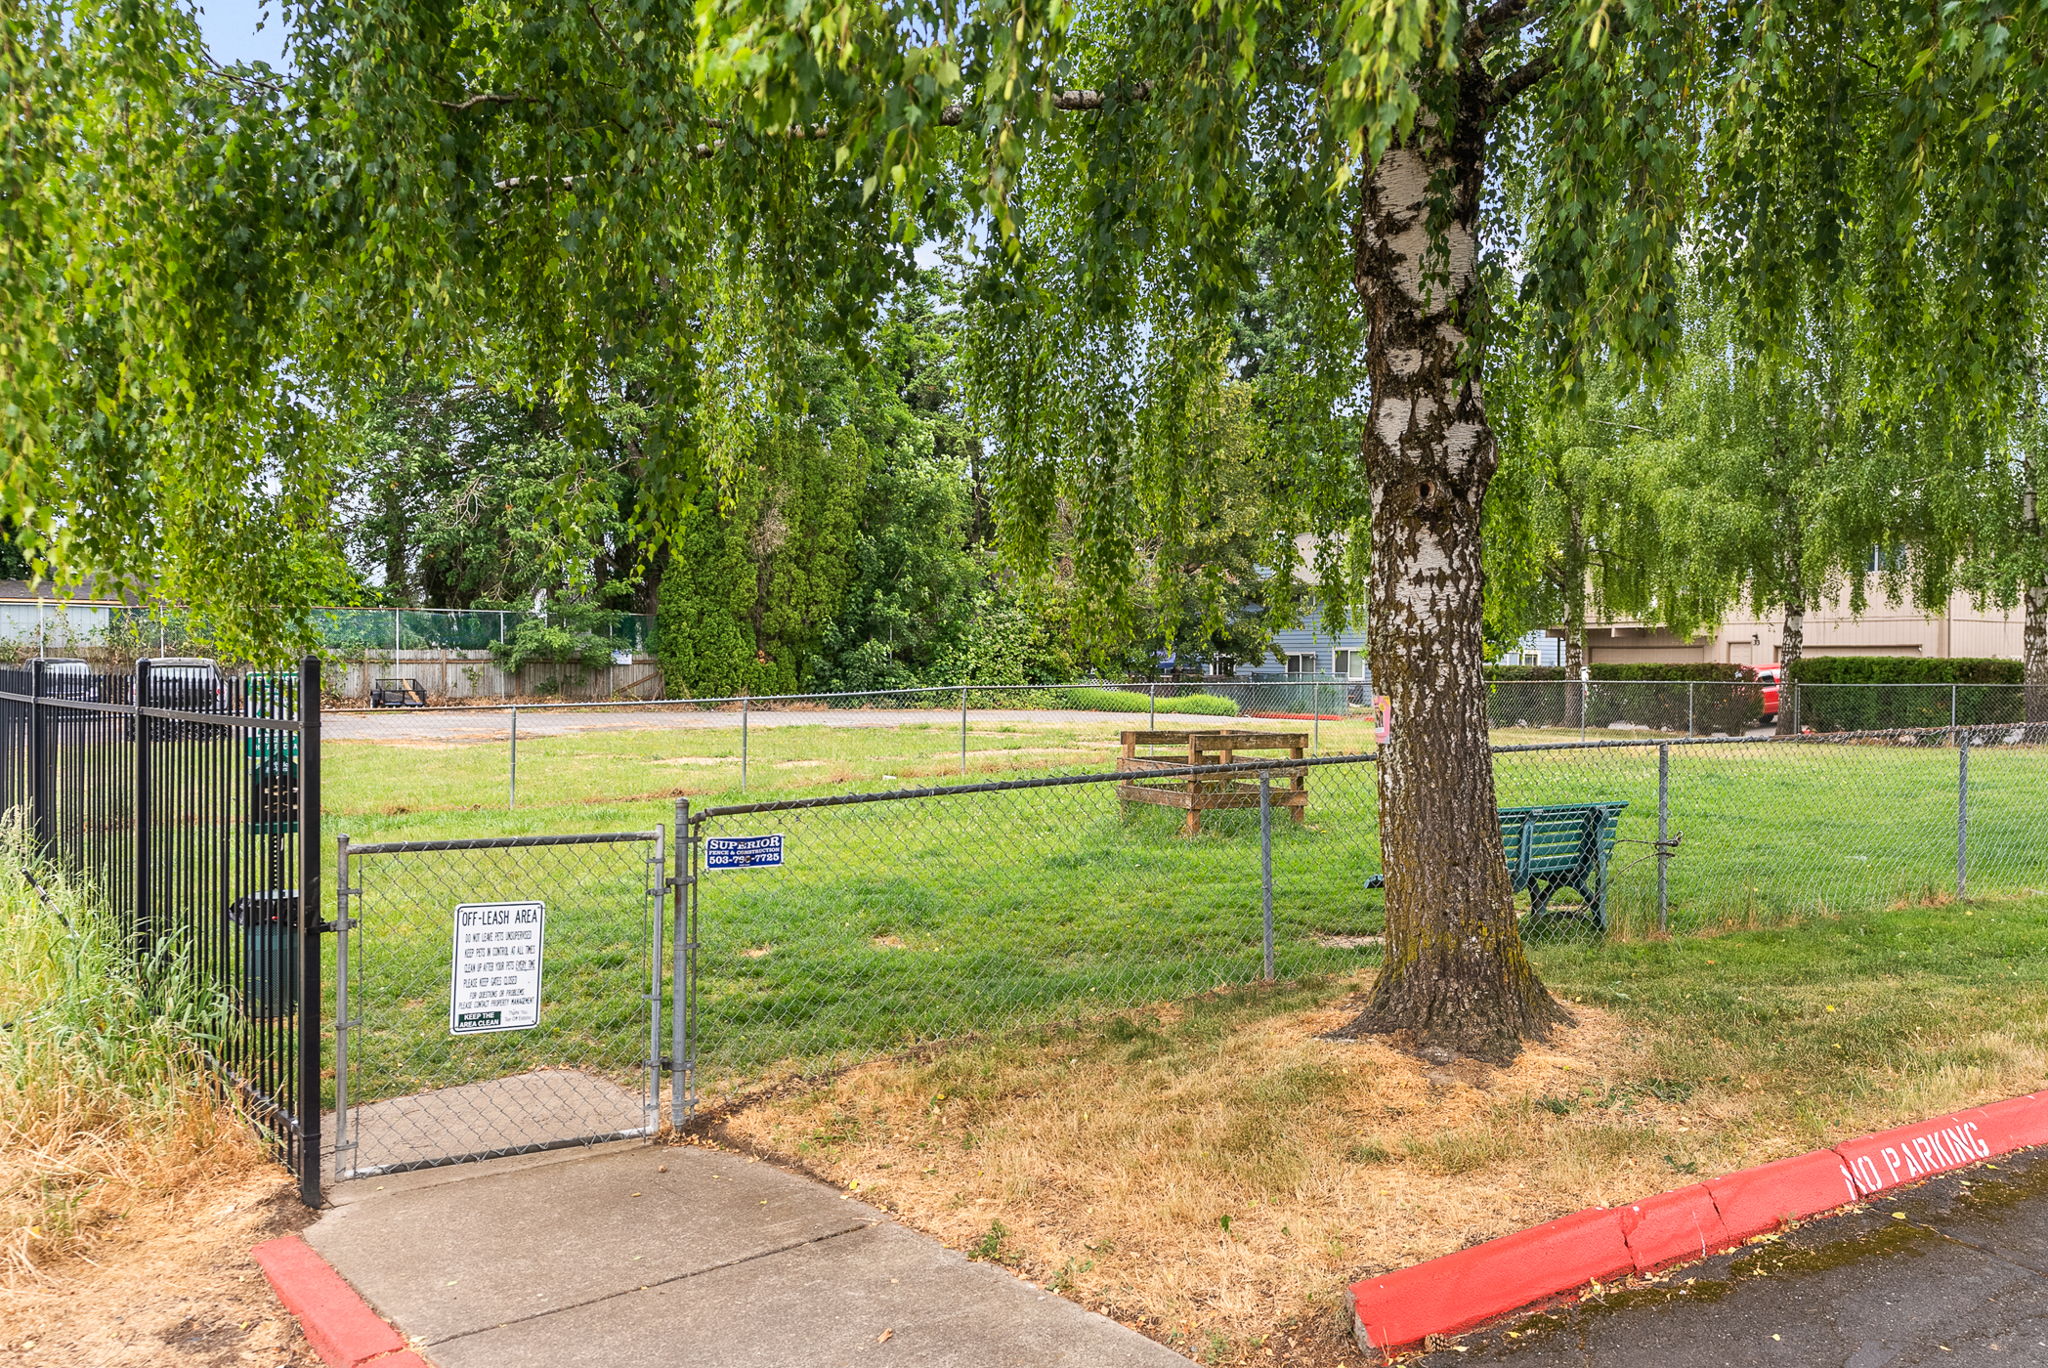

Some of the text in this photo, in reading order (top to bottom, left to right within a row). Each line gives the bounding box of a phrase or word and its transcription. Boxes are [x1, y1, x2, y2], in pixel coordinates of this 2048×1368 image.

[710, 837, 780, 849] SUPERIOR
[736, 847, 780, 855] CONSTRUCTION
[462, 909, 538, 926] OFF-LEASH AREA
[495, 932, 504, 941] PETS
[465, 948, 474, 958] KEEP
[476, 948, 485, 957] PETS
[1840, 1122, 1990, 1200] NO PARKING
